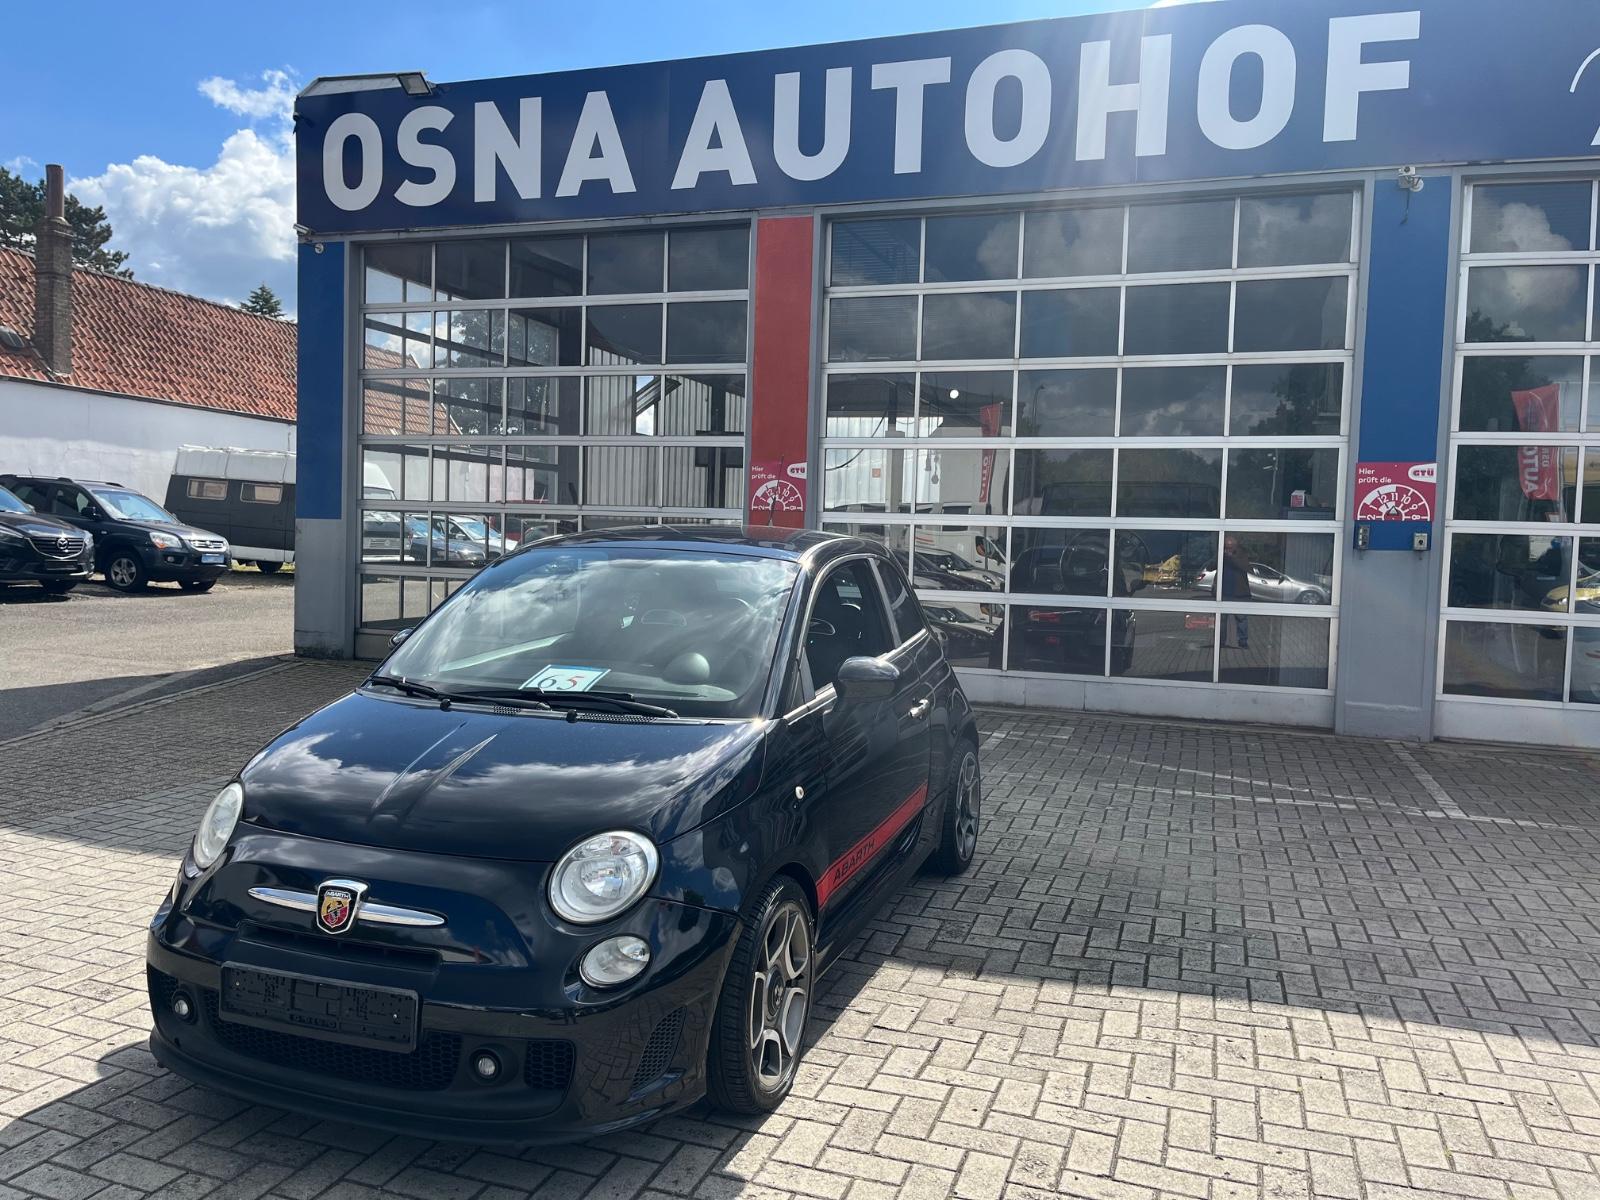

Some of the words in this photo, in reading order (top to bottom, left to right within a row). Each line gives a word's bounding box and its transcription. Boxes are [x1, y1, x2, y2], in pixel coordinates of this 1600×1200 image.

[322, 90, 637, 212] OSNA
[671, 10, 1421, 190] AUTOHOF
[1413, 468, 1434, 477] GTÜ
[1377, 495, 1389, 504] 12
[1391, 493, 1399, 501] 11
[1401, 494, 1412, 504] 10
[832, 839, 875, 885] ABARTH
